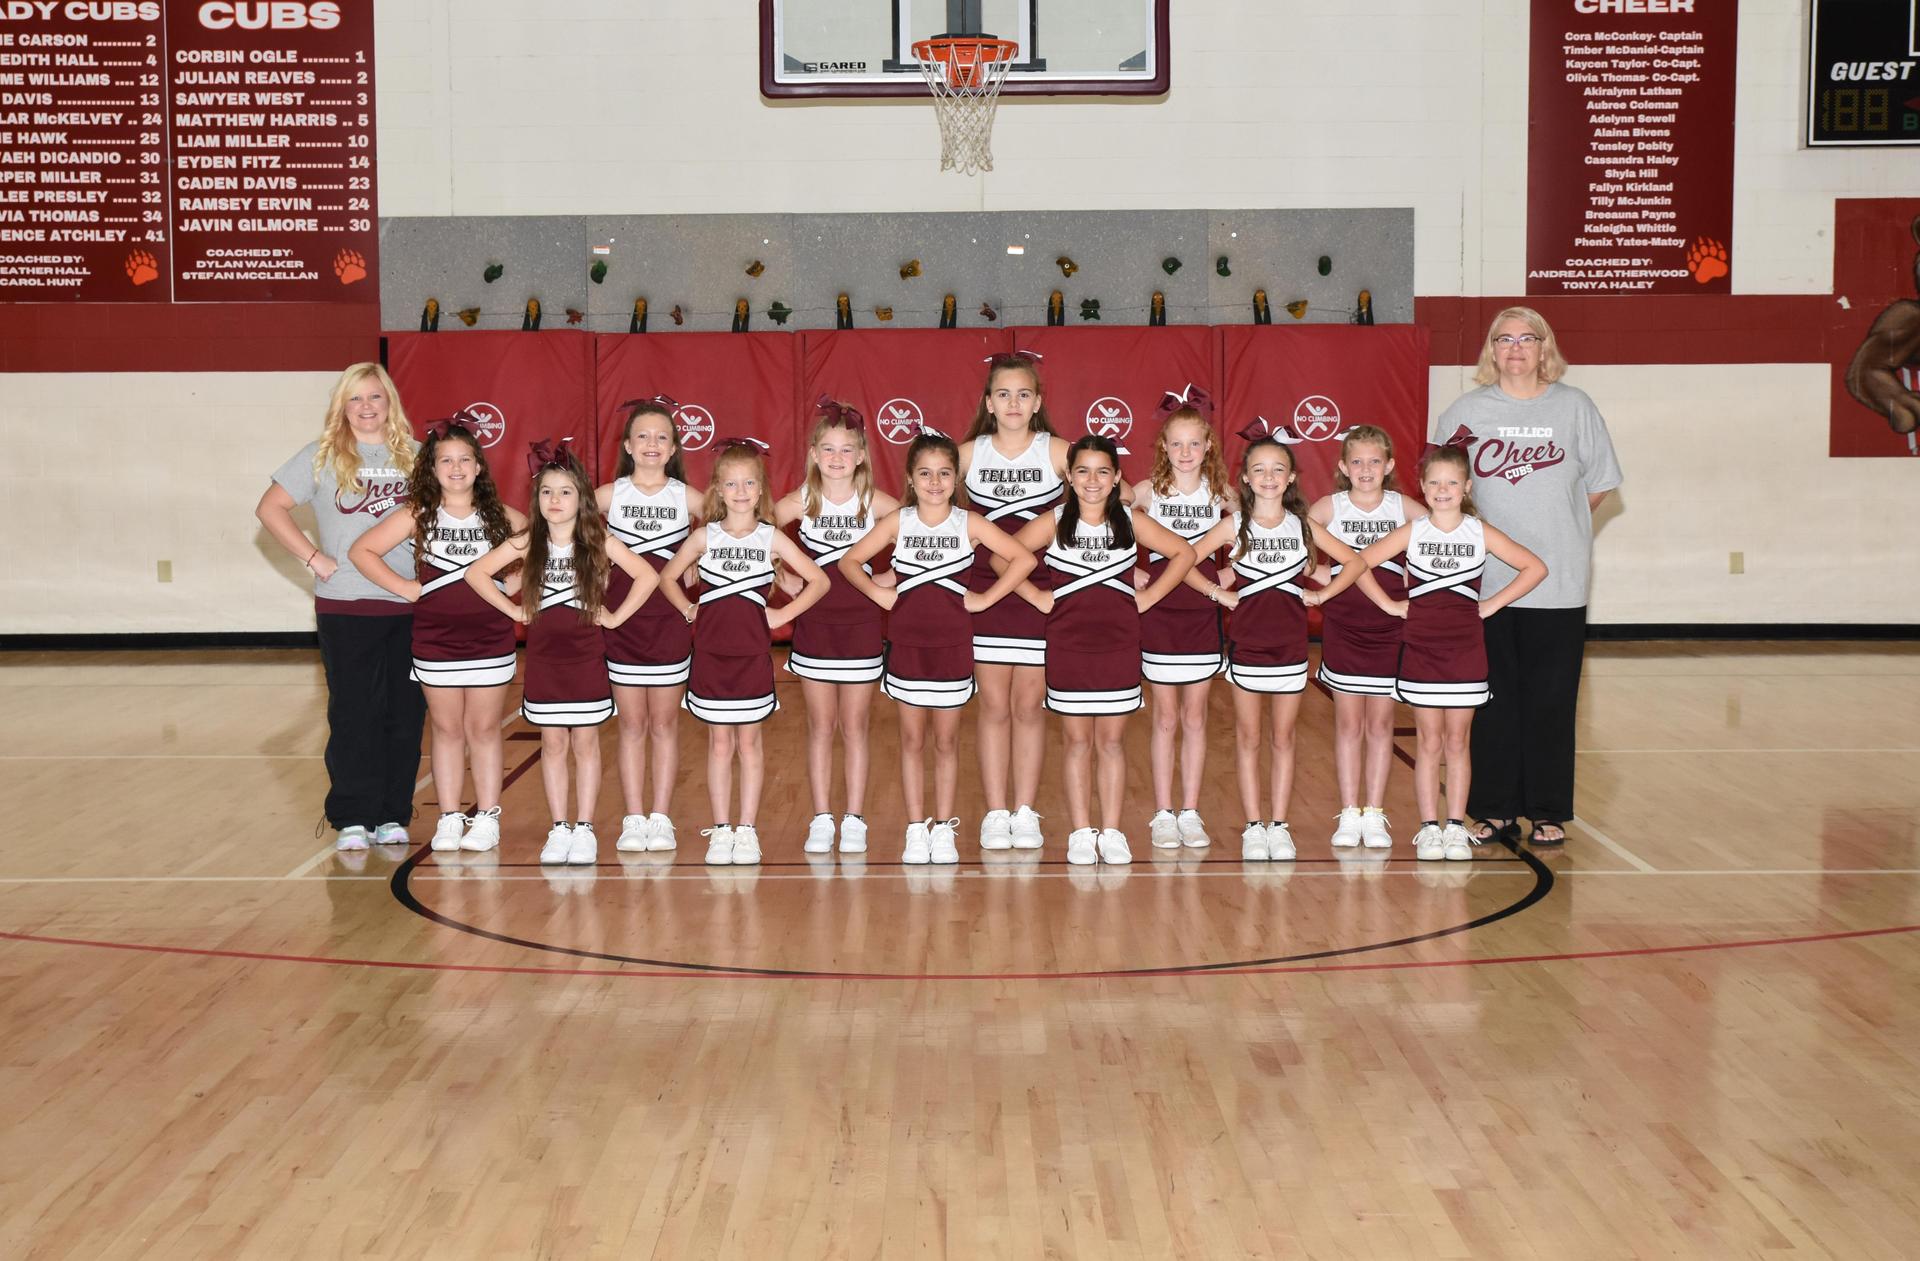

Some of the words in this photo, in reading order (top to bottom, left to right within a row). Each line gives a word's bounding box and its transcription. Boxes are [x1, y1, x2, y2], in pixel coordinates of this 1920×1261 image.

[64, 1, 161, 21] CUBS
[1574, 0, 1695, 14] CHEER
[198, 1, 341, 30] CUBS
[18, 33, 88, 47] CARSON
[146, 33, 157, 47] 2
[1564, 31, 1592, 41] Cora
[1658, 31, 1703, 43] Captain
[175, 49, 245, 64] CORBIN
[249, 49, 298, 64] OGLE
[355, 49, 366, 64] 1
[1562, 45, 1604, 55] Timber
[0, 53, 51, 67] EDITH
[55, 53, 99, 67] HALL
[146, 53, 158, 67] 4
[1565, 72, 1599, 83] Olivia
[1830, 61, 1916, 81] GUEST
[28, 73, 111, 87] WILLIAMS
[139, 73, 160, 87] 12
[174, 71, 240, 85] JULIAN
[244, 71, 316, 85] REAVES
[356, 71, 368, 85] 2
[1583, 86, 1637, 98] Akiralynn
[1639, 86, 1682, 97] Latham
[2, 92, 53, 106] DAVIS
[140, 92, 160, 106] 13
[175, 92, 251, 106] SAWYER
[254, 92, 305, 106] WEST
[356, 92, 368, 106] 3
[1586, 100, 1627, 110] Aubree
[1629, 100, 1679, 110] Coleman
[33, 112, 124, 126] McKELVEY
[142, 112, 163, 126] 24
[175, 113, 266, 127] MATTHEW
[270, 113, 338, 127] HARRIS
[357, 113, 369, 127] 5
[1589, 114, 1635, 126] Adelynn
[1637, 113, 1676, 123] Sewell
[17, 131, 68, 145] HAWK
[140, 131, 161, 145] 25
[1593, 127, 1630, 137] Alaina
[1632, 127, 1671, 137] Bivens
[177, 134, 221, 148] LIAM
[225, 134, 291, 148] MILLER
[348, 134, 369, 148] 10
[1590, 141, 1635, 153] Tensley
[0, 151, 36, 165] AEH
[40, 151, 122, 165] DICANDIO
[140, 151, 161, 165] 30
[177, 155, 237, 169] EYDEN
[241, 155, 282, 169] FITZ
[348, 155, 370, 169] 14
[1584, 154, 1645, 165] Cassandra
[1646, 154, 1679, 166] Haley
[40, 170, 102, 184] MILLER
[140, 170, 160, 184] 31
[1604, 168, 1637, 180] Shyla
[1638, 168, 1658, 178] Hill
[177, 176, 238, 190] CADEN
[243, 176, 298, 190] DAVIS
[348, 176, 371, 190] 23
[1589, 182, 1623, 194] Fallyn
[1625, 182, 1674, 192] Kirkland
[33, 190, 108, 204] PRESLEY
[141, 190, 162, 204] 32
[1589, 196, 1615, 208] Tilly
[1617, 195, 1672, 206] McJunkin
[179, 197, 253, 211] RAMSEY
[257, 197, 312, 211] ERVIN
[348, 197, 371, 211] 24
[28, 209, 100, 223] THOMAS
[142, 209, 163, 223] 34
[1641, 209, 1677, 221] Payne
[178, 218, 233, 232] JAVIN
[237, 218, 319, 232] GILMORE
[349, 218, 371, 232] 30
[1636, 223, 1677, 233] Whittle
[0, 229, 46, 242] ENCE
[49, 229, 127, 242] ATCHLEY
[145, 229, 166, 242] 41
[1574, 237, 1613, 247] Phenix
[206, 248, 272, 257] COACHED
[196, 260, 244, 269] DYLAN
[244, 260, 304, 269] WALKER
[1565, 258, 1631, 267] COACHED
[54, 266, 91, 275] HALL
[182, 271, 235, 280] STEFAN
[1528, 270, 1586, 279] ANDREA
[1587, 269, 1689, 279] LEATHERWOOD
[0, 278, 46, 287] CAROL
[46, 278, 83, 287] HUNT
[1561, 281, 1609, 290] TONYA
[1609, 280, 1655, 289] HALEY
[880, 418, 890, 426] NO
[1296, 415, 1307, 423] NO
[1497, 427, 1553, 438] TELLICO
[1474, 438, 1565, 478] Cheer
[979, 468, 1043, 483] TELLICO
[1504, 464, 1534, 480] CUBS
[335, 479, 407, 514] Chee
[992, 484, 1026, 497] Cubs
[367, 497, 396, 514] CUBS
[1159, 503, 1214, 519] TELLICO
[621, 505, 677, 520] TELLICO
[633, 519, 662, 531] Cubs
[1172, 518, 1199, 530] Cubs
[1341, 520, 1397, 533] TELLICO
[823, 529, 852, 541] Cubs
[1355, 533, 1379, 546] Cub
[903, 535, 960, 550] TELLICO
[1248, 537, 1300, 551] ELLICO
[445, 543, 479, 556] Cubs
[710, 547, 766, 563] TELLICO
[914, 549, 944, 561] Cubs
[1081, 550, 1110, 562] Cubs
[1417, 541, 1475, 558] TELLICO
[1257, 551, 1286, 564] Cubs
[1430, 557, 1460, 569] Cubs
[721, 560, 751, 572] Cubs
